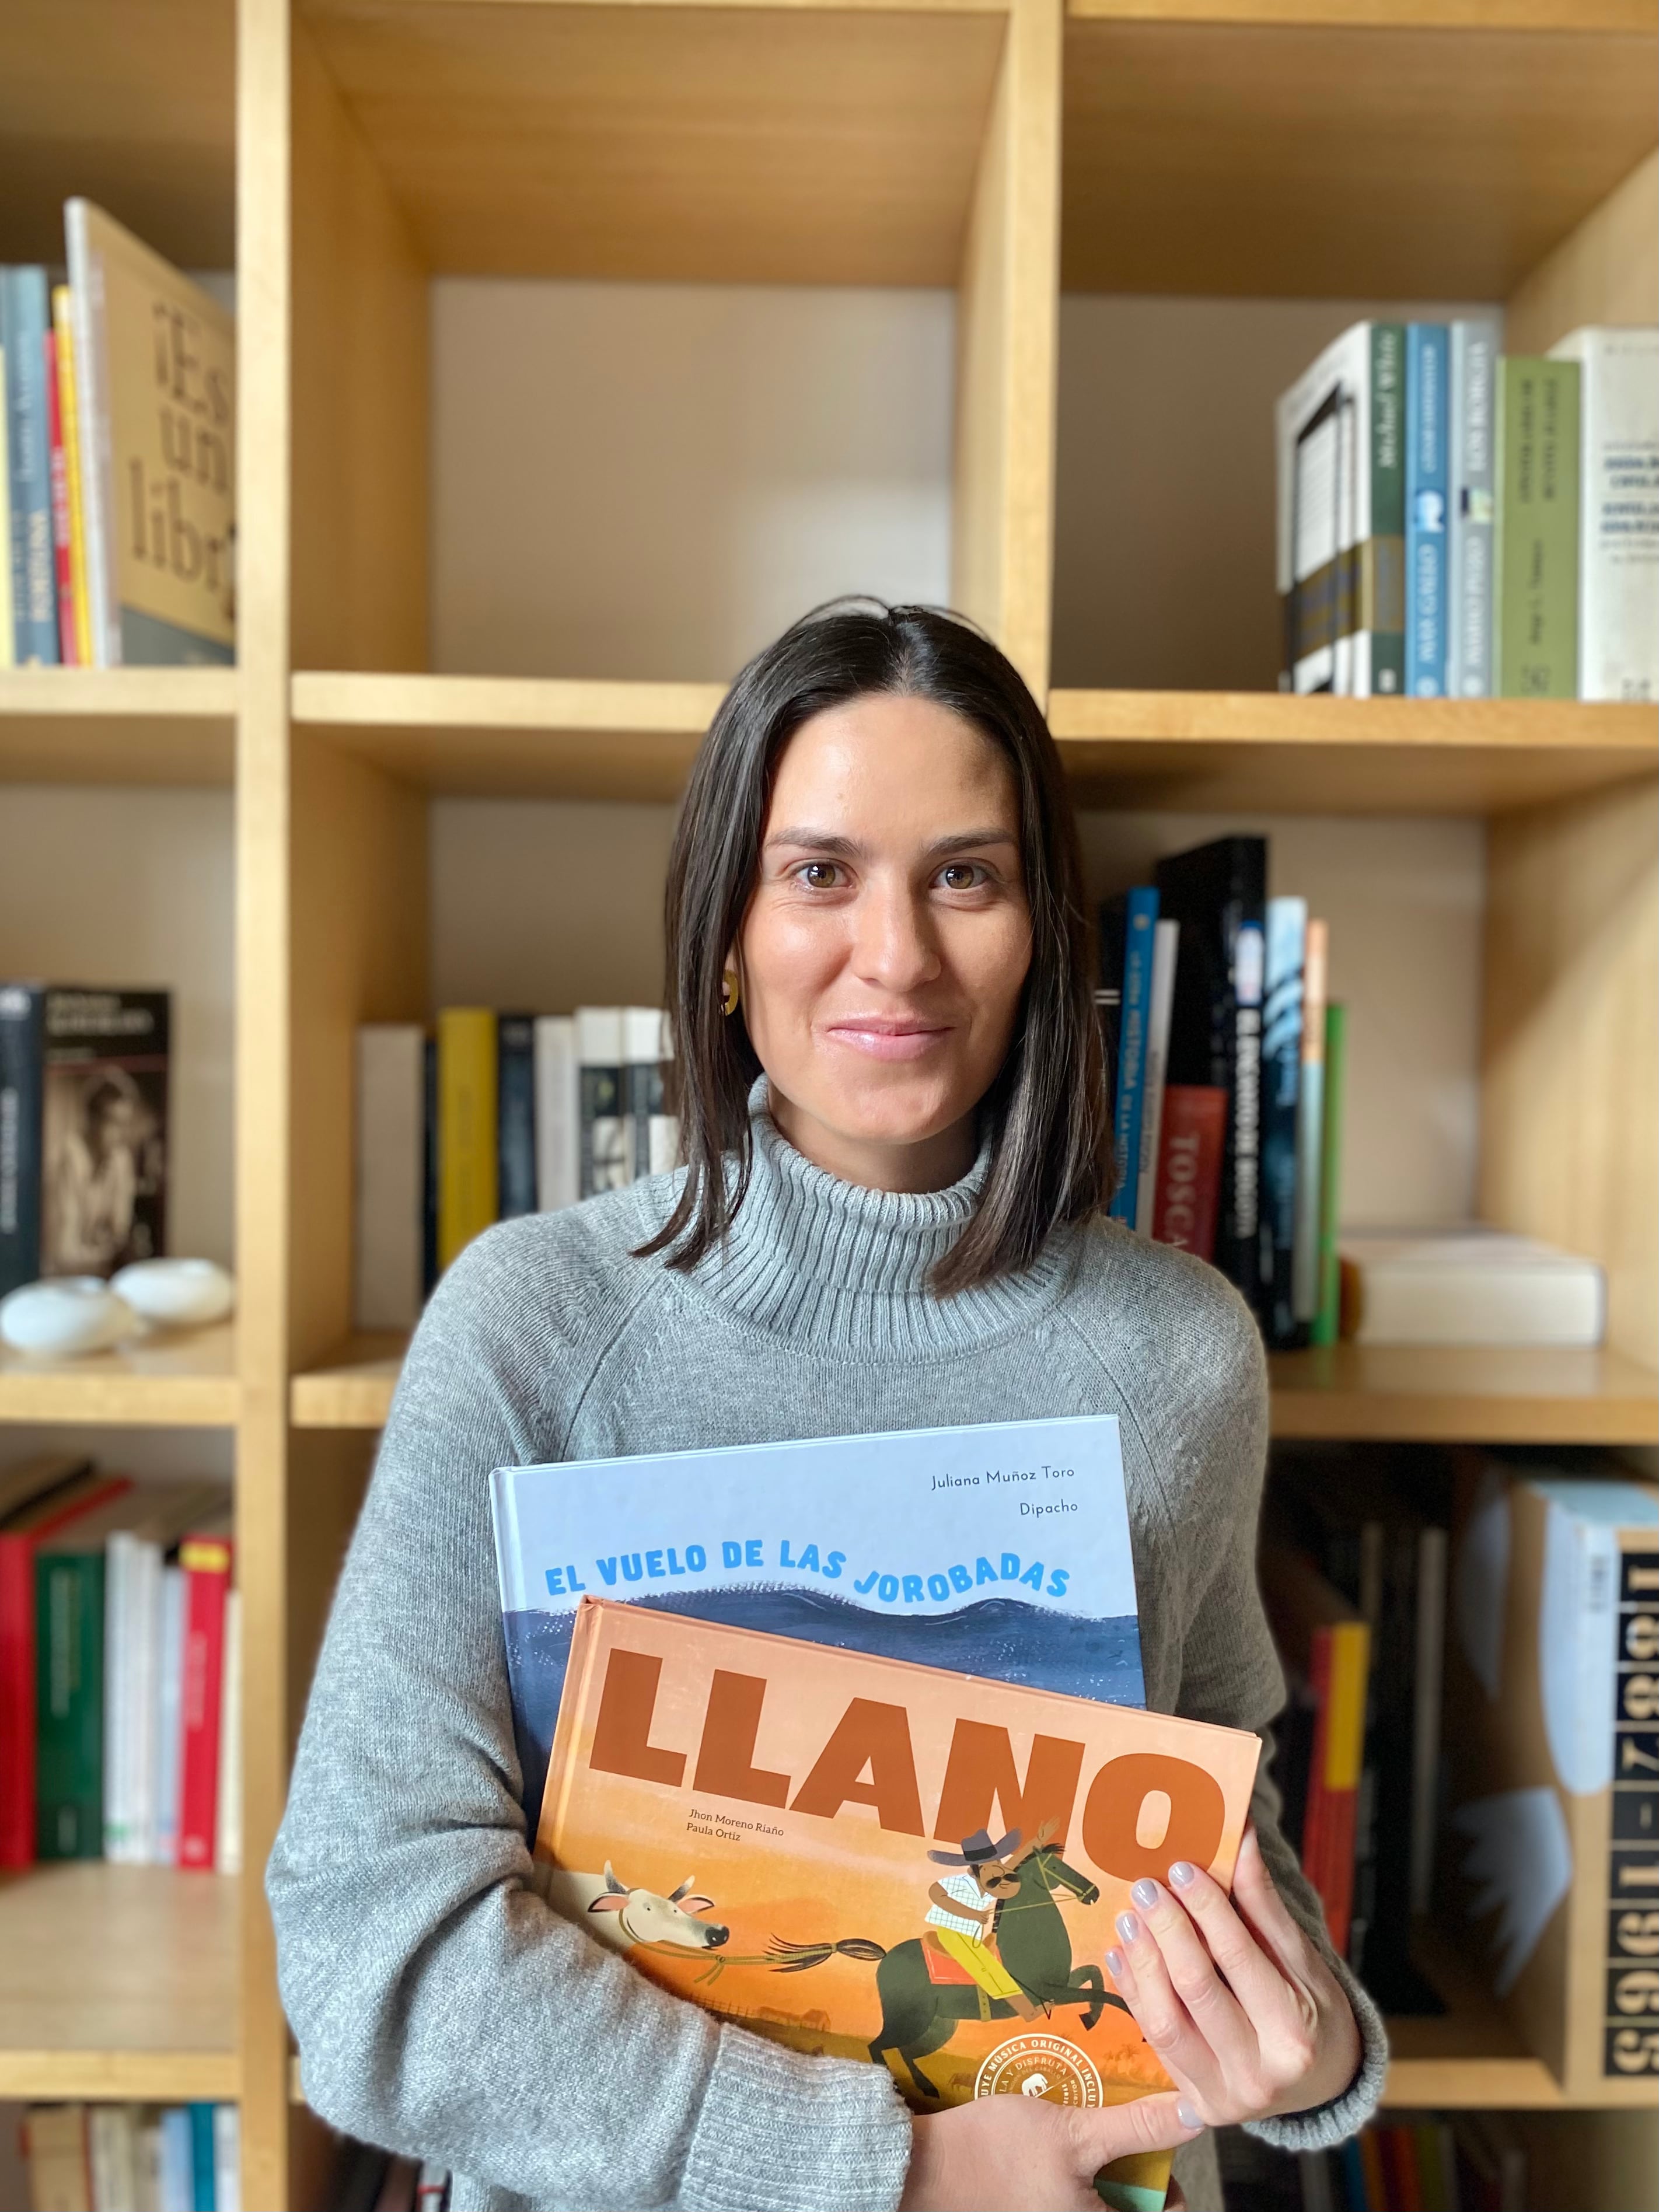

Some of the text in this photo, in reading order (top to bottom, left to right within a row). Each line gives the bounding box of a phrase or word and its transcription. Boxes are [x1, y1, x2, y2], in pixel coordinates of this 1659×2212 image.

[159, 406, 228, 495] un
[931, 1466, 1074, 1491] Juliana Muñoz Toro
[1020, 1499, 1078, 1518] Dipacho
[545, 1539, 1071, 1603] EL VUELO DE LAS JOROBADAS
[589, 1648, 1225, 1889] LLANO
[686, 1822, 741, 1841] Paula Ortiz
[689, 1809, 784, 1836] Jhon Moreno Riaño
[988, 2042, 1026, 2072] MÚSICA
[1031, 2039, 1083, 2067] ORIGINAL
[1015, 2056, 1067, 2075] DISFRUTA
